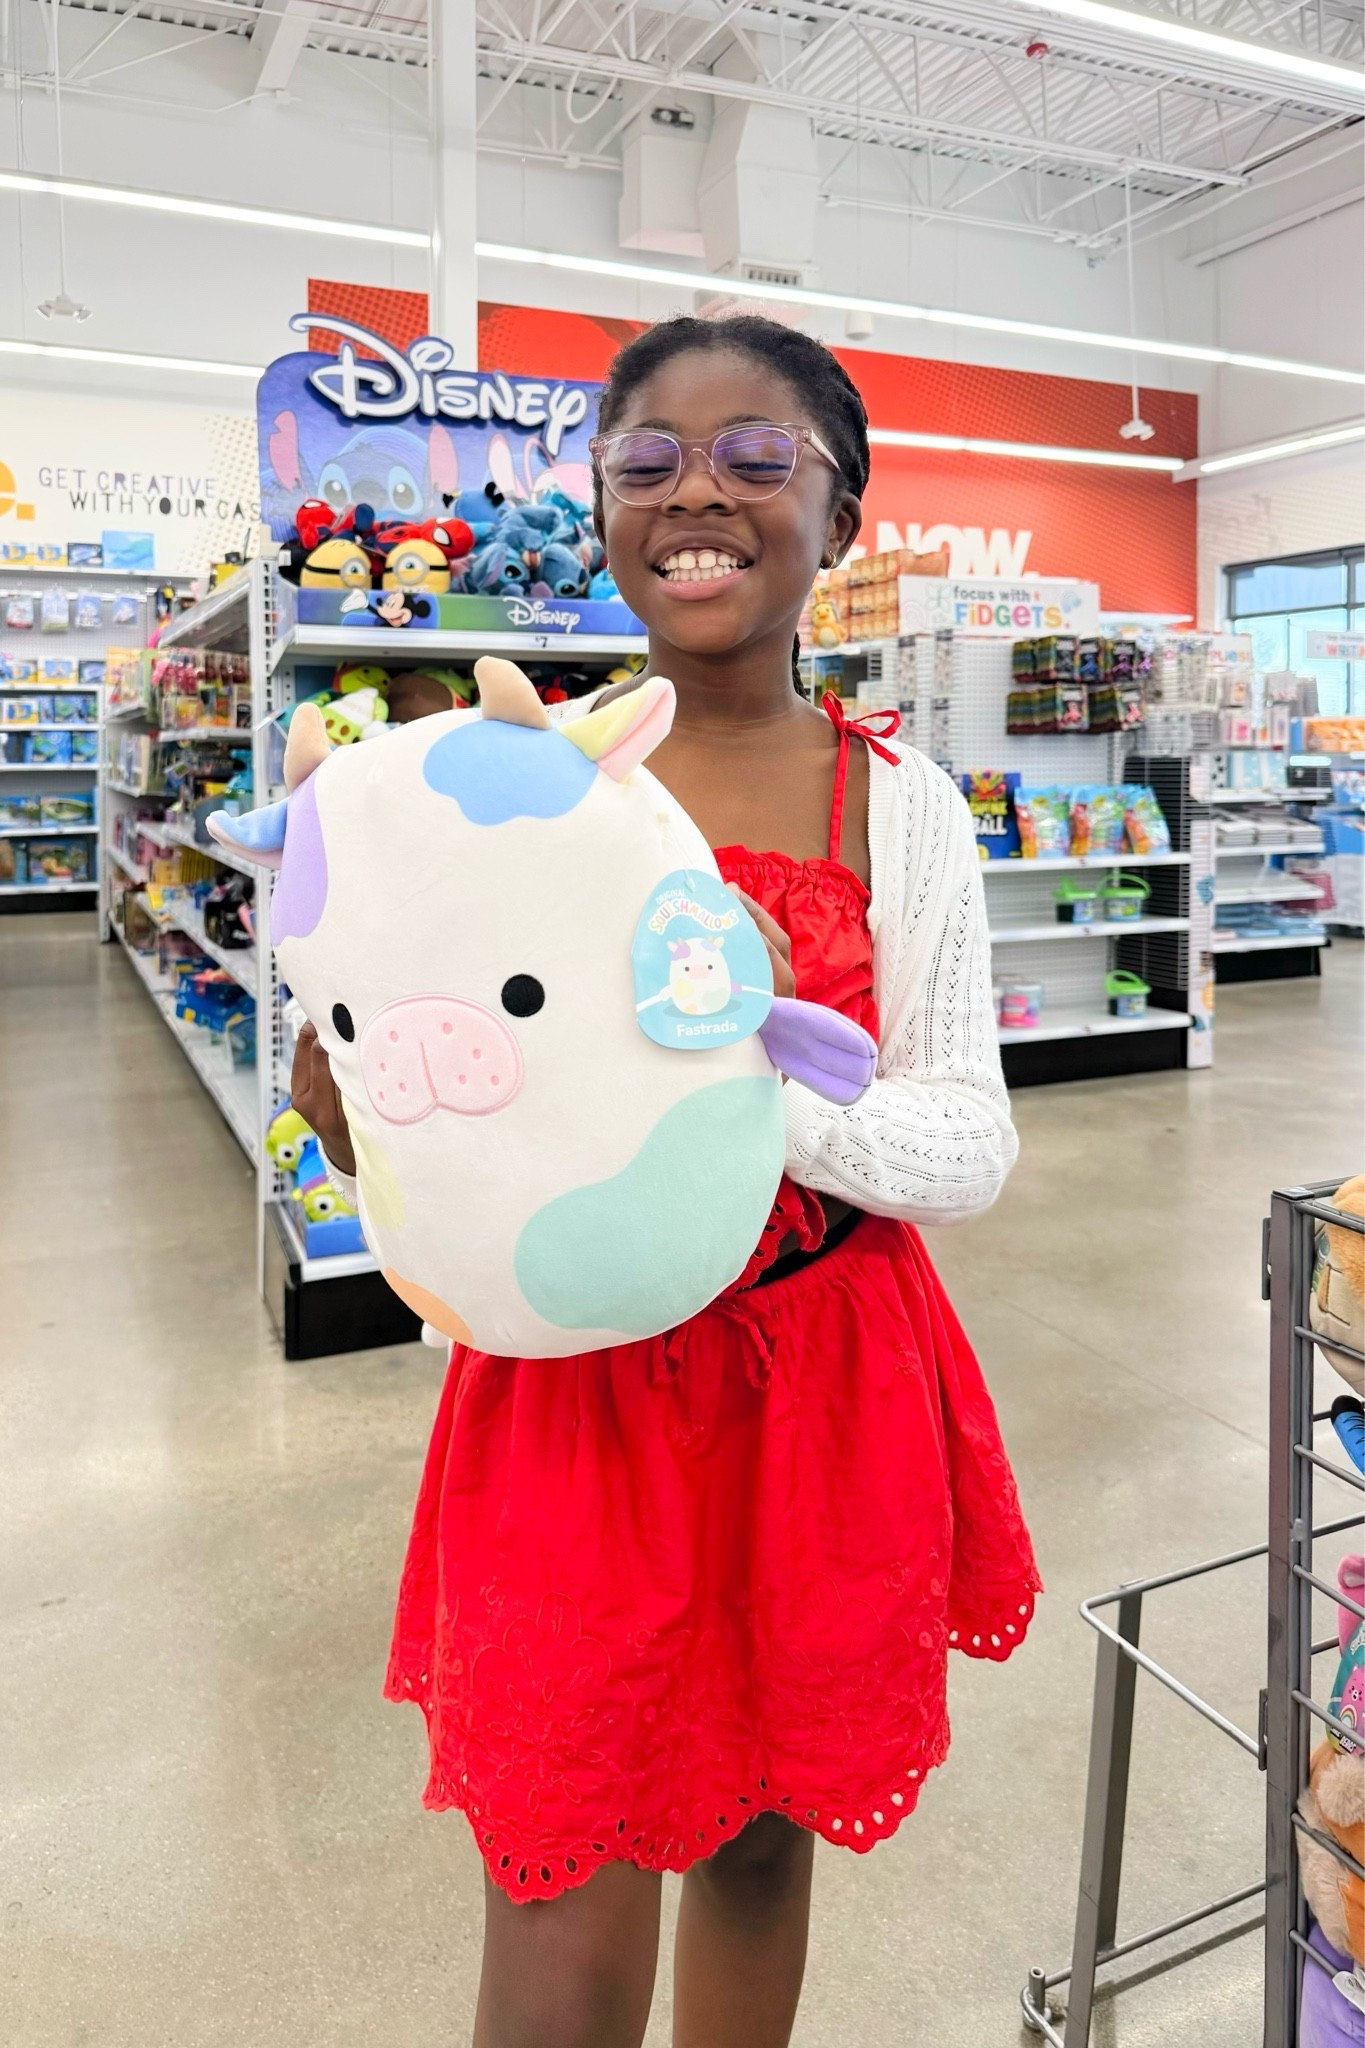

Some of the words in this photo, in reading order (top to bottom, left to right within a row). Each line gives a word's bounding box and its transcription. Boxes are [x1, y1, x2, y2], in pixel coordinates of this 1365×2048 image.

[38, 466, 86, 490] GET
[97, 471, 215, 499] CREATIVE
[70, 491, 133, 515] WITH
[143, 497, 206, 518] YOUR
[953, 585, 994, 600] focus
[999, 587, 1031, 602] with
[648, 899, 739, 935] SQUISHMALLOWS
[676, 1020, 738, 1037] Fastrada
